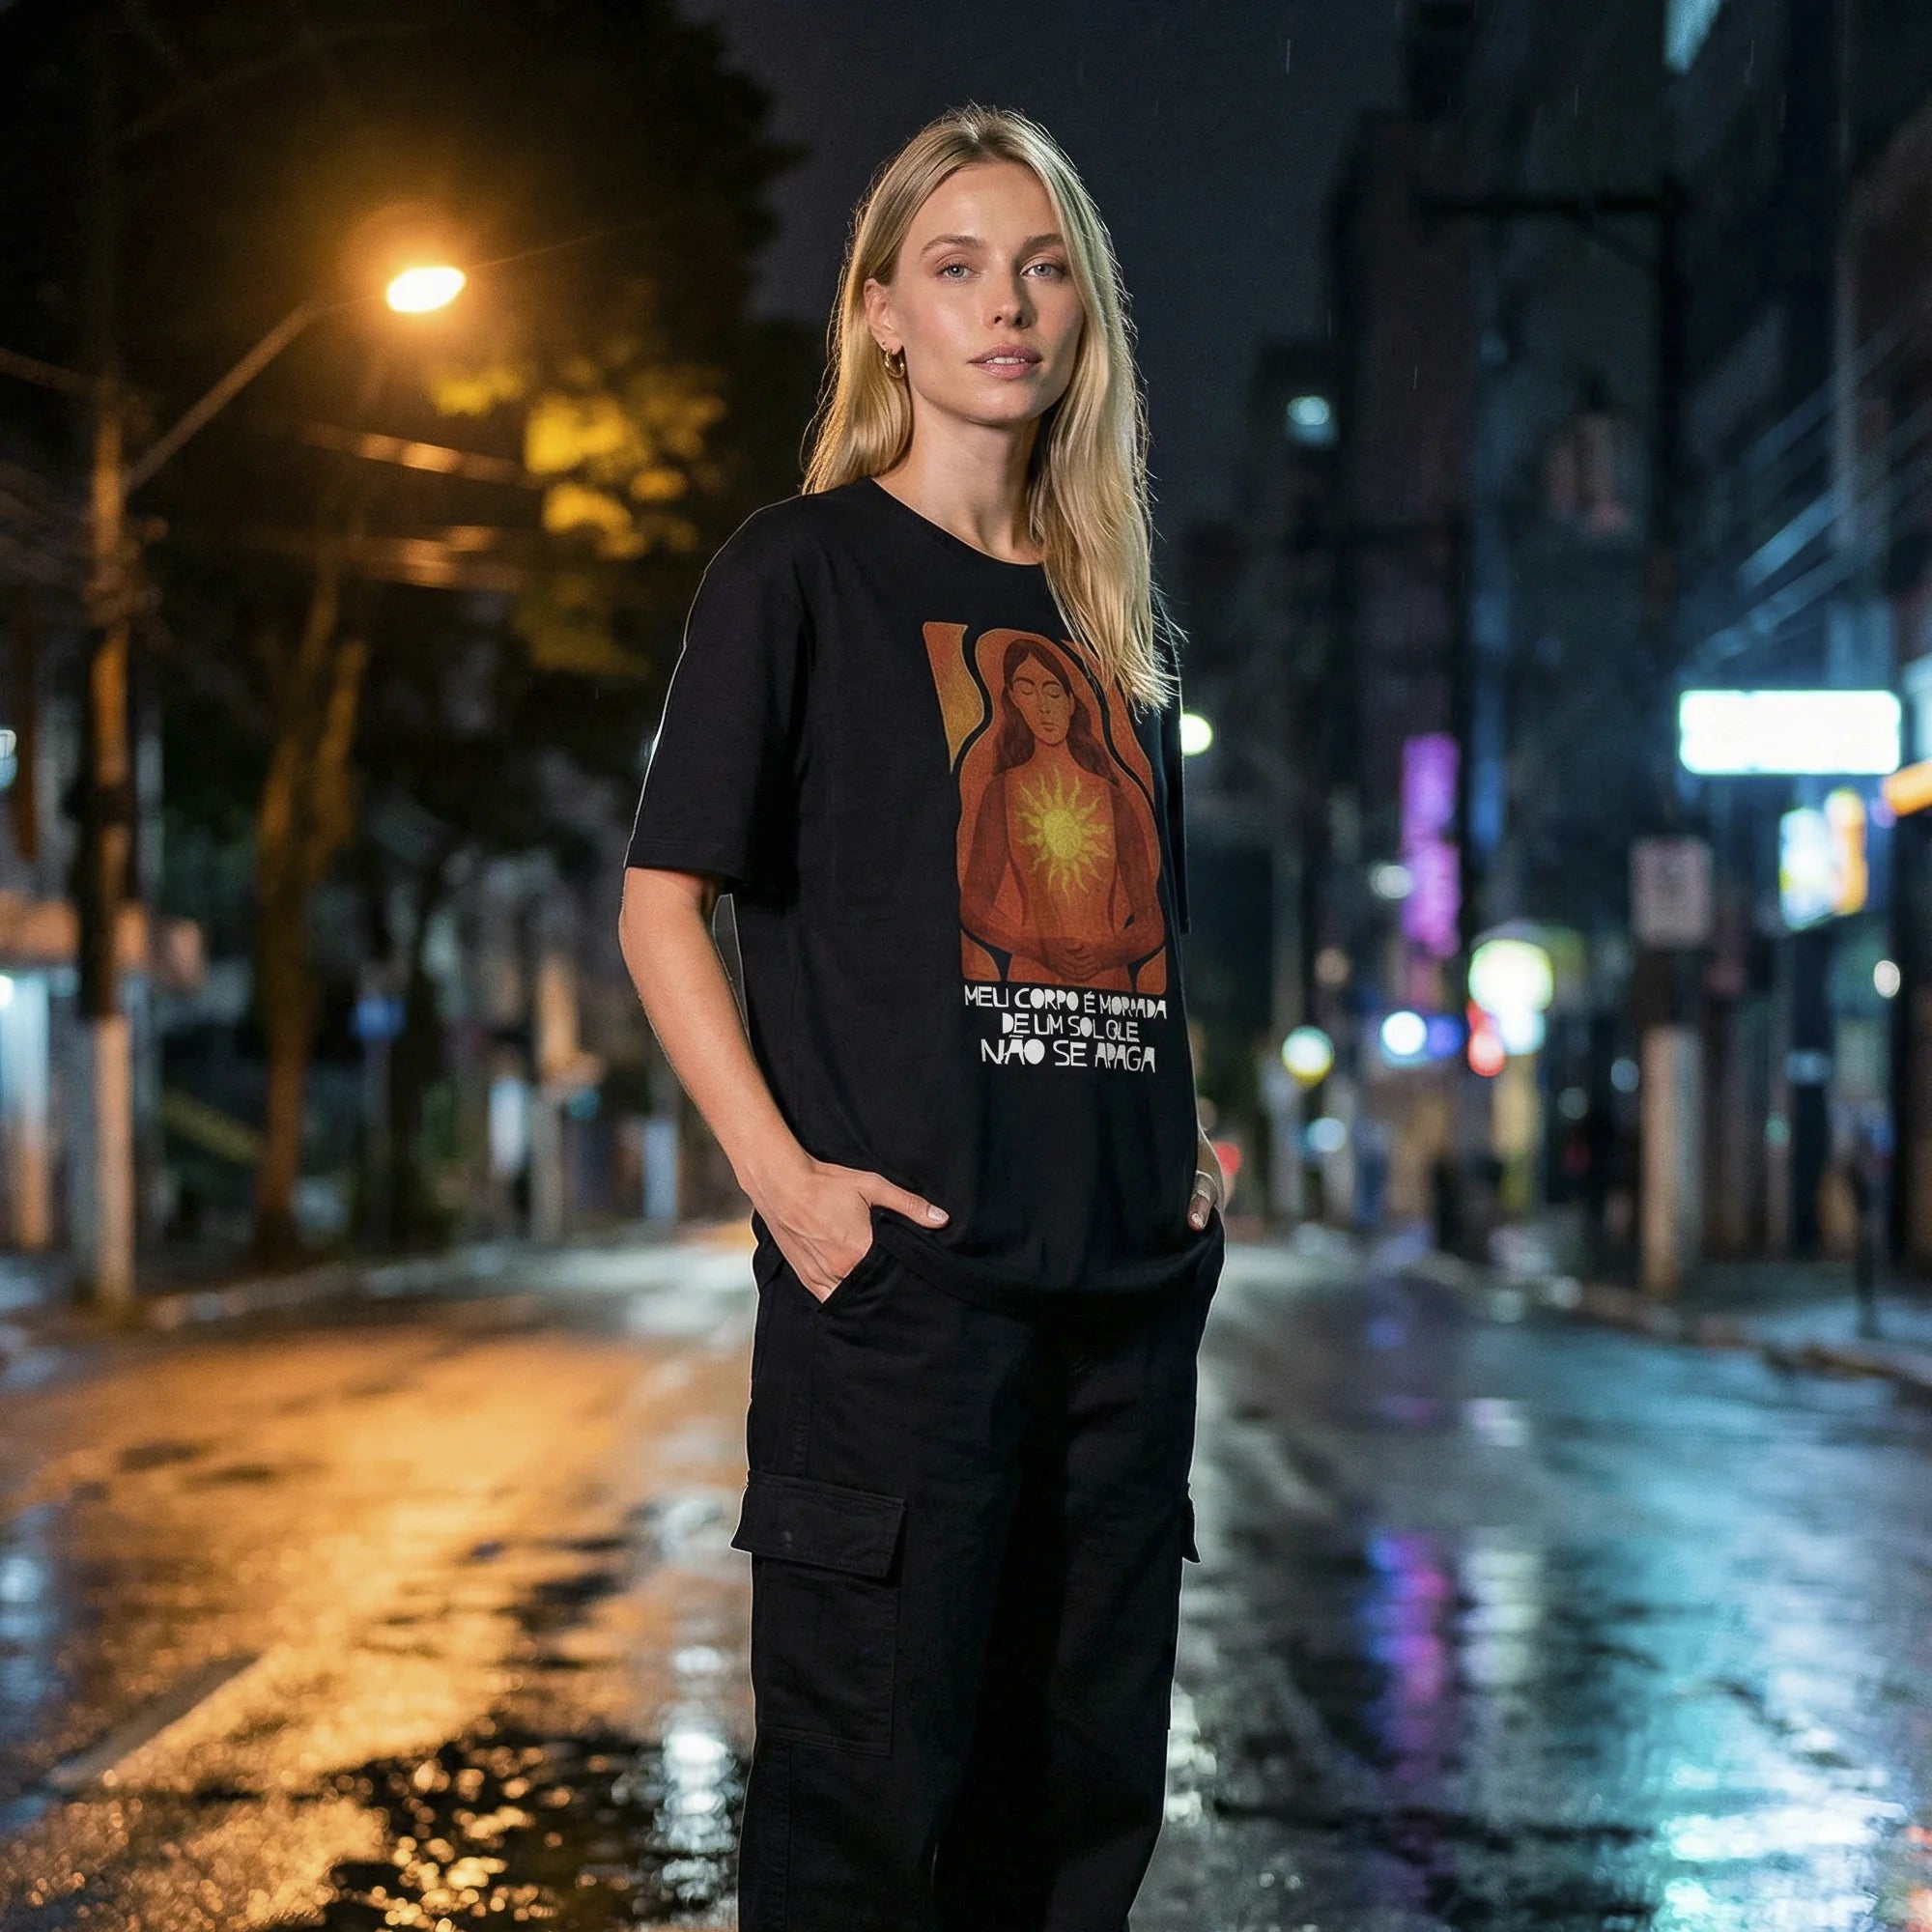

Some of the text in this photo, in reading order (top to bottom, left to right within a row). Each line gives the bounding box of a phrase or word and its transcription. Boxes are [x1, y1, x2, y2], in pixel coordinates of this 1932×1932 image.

[964, 985, 1009, 1008] MEU
[1014, 987, 1079, 1011] CORPO
[1084, 991, 1096, 1013] É
[1002, 1012, 1030, 1034] DE
[1035, 1014, 1064, 1035] UM
[1067, 1015, 1104, 1039] SOL
[980, 1035, 1155, 1073] NÃO SE APAGA
